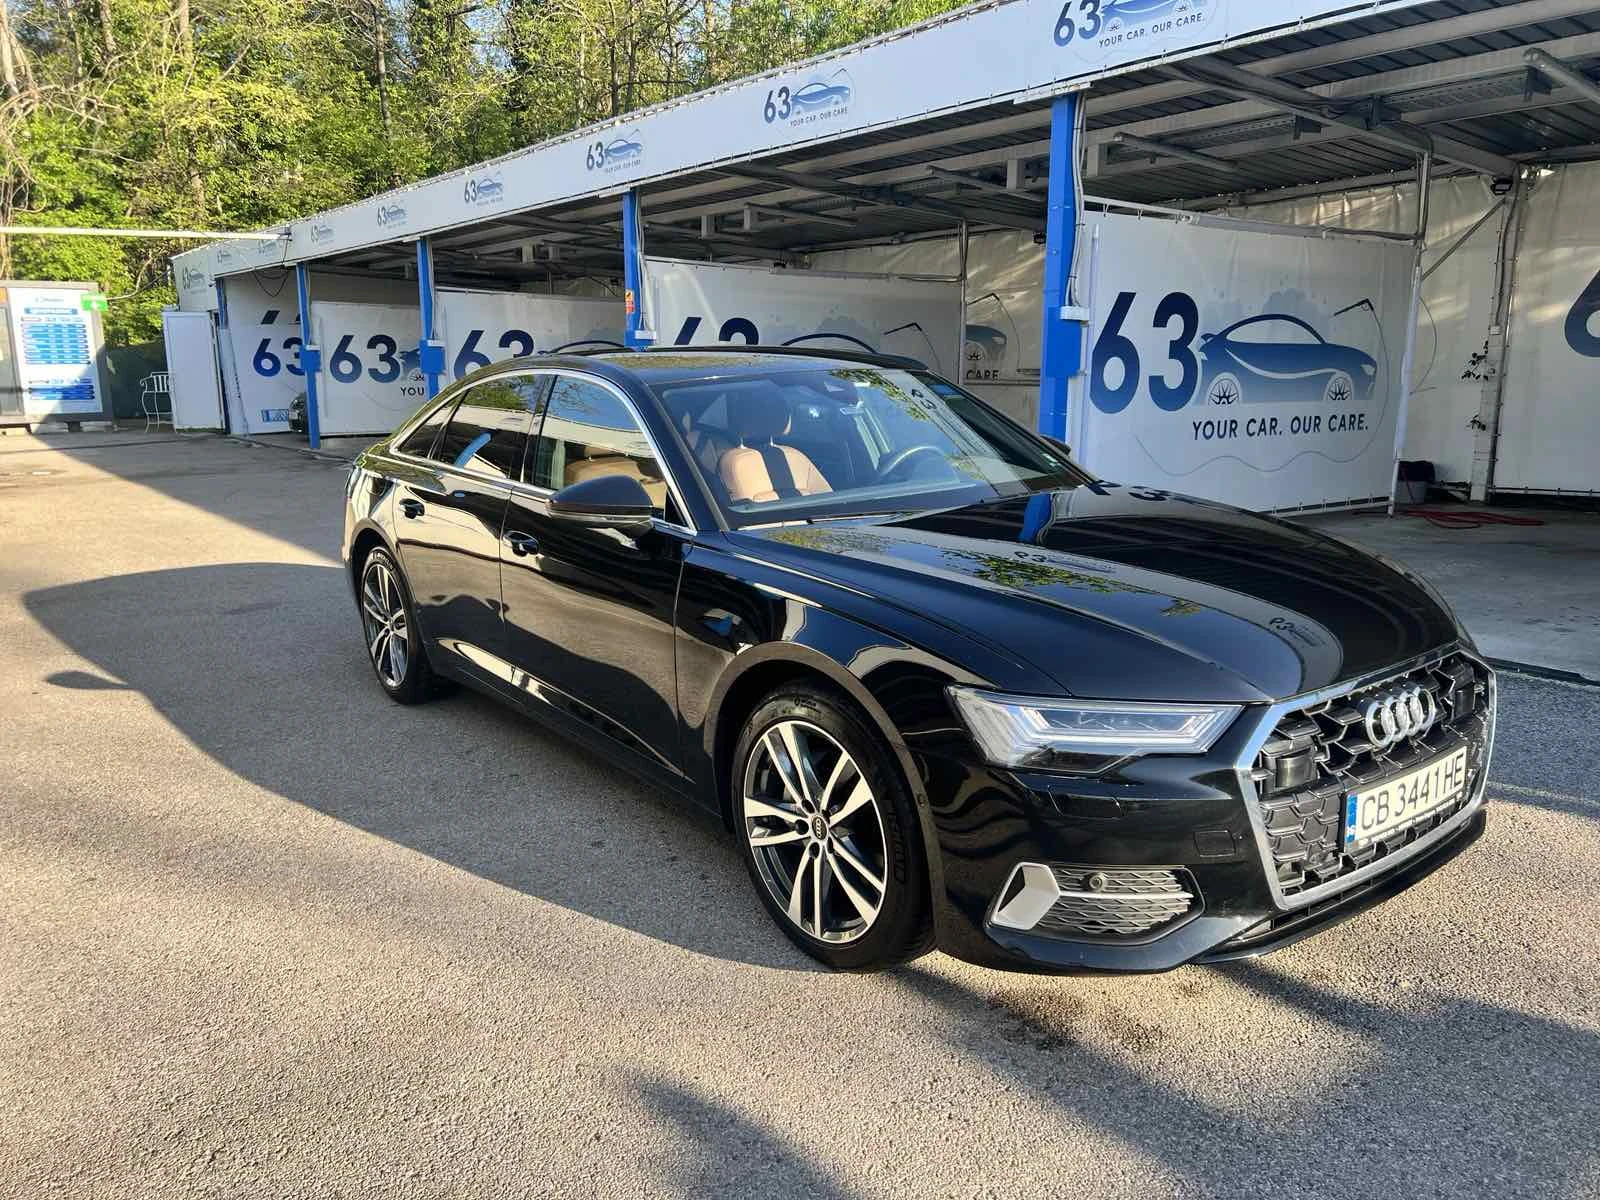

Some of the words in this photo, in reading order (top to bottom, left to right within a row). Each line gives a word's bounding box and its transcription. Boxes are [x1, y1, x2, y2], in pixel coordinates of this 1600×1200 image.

[1053, 0, 1101, 47] 63
[1099, 34, 1123, 48] YOUR
[1151, 21, 1173, 34] OUR
[764, 86, 791, 123] 63
[586, 141, 604, 171] 63
[464, 179, 477, 203] 63
[253, 336, 306, 377] 63
[330, 334, 400, 384] 63
[1089, 291, 1199, 414] 63
[400, 386, 425, 397] YOU
[1192, 419, 1238, 441] YOUR
[1246, 417, 1282, 437] CAR.
[1290, 414, 1321, 434] OUR
[1328, 412, 1369, 431] CARE.
[1361, 790, 1390, 830] CB
